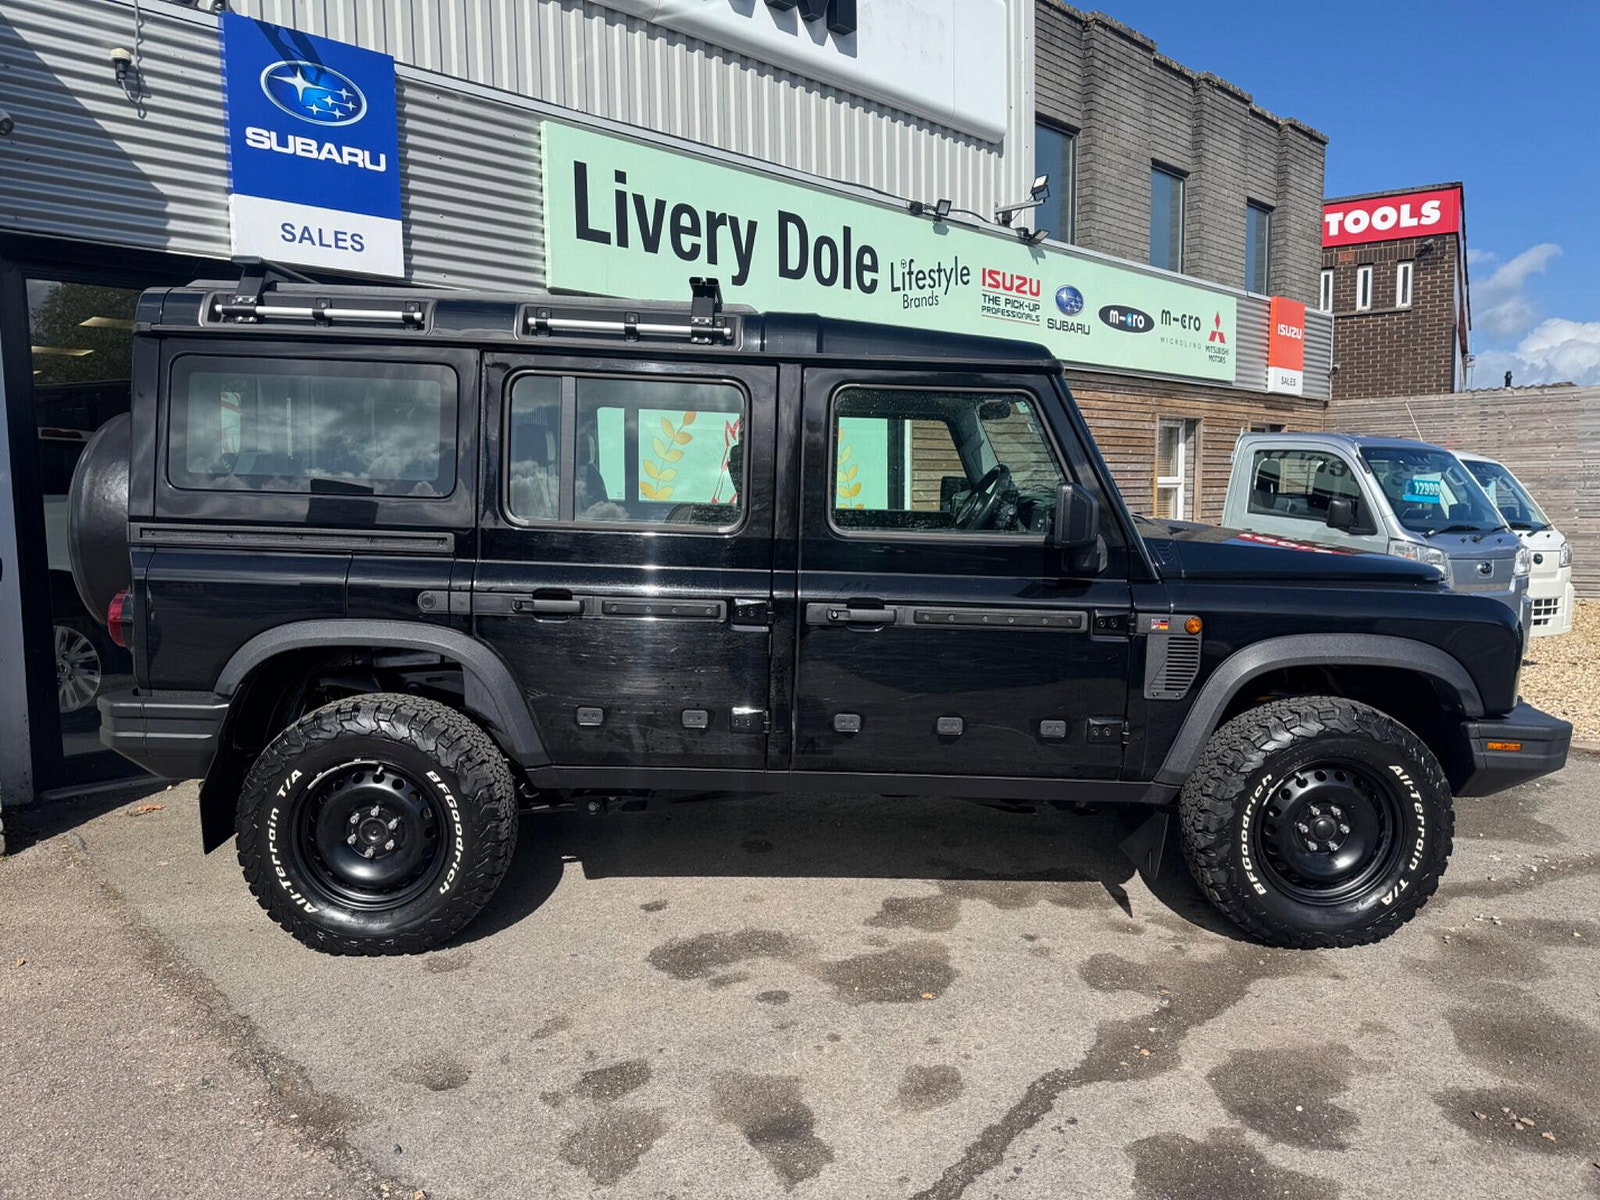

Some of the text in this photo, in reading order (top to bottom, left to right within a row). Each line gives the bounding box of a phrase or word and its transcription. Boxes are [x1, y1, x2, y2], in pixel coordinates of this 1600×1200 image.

[245, 126, 387, 172] SUBARU
[573, 160, 879, 294] Livery Dole
[1324, 200, 1441, 236] TOOLS
[280, 222, 365, 252] SALES
[890, 255, 970, 295] Lifestyle
[981, 267, 1040, 297] ISUZU
[902, 290, 939, 309] Brands
[981, 305, 1040, 322] PROFESSIONALS
[982, 293, 1040, 312] THE PICK-UP
[1047, 318, 1091, 335] SUBARU
[1277, 323, 1302, 340] ISUZU
[1205, 344, 1230, 356] MITSUBISHI
[1208, 354, 1226, 364] MOTORS
[1281, 376, 1296, 387] SALES
[268, 769, 320, 913] All-Terrain T/A
[426, 770, 464, 895] BFGoodrich
[1240, 773, 1274, 896] BFGoodrich
[1381, 764, 1425, 906] All-Terrain T/A
